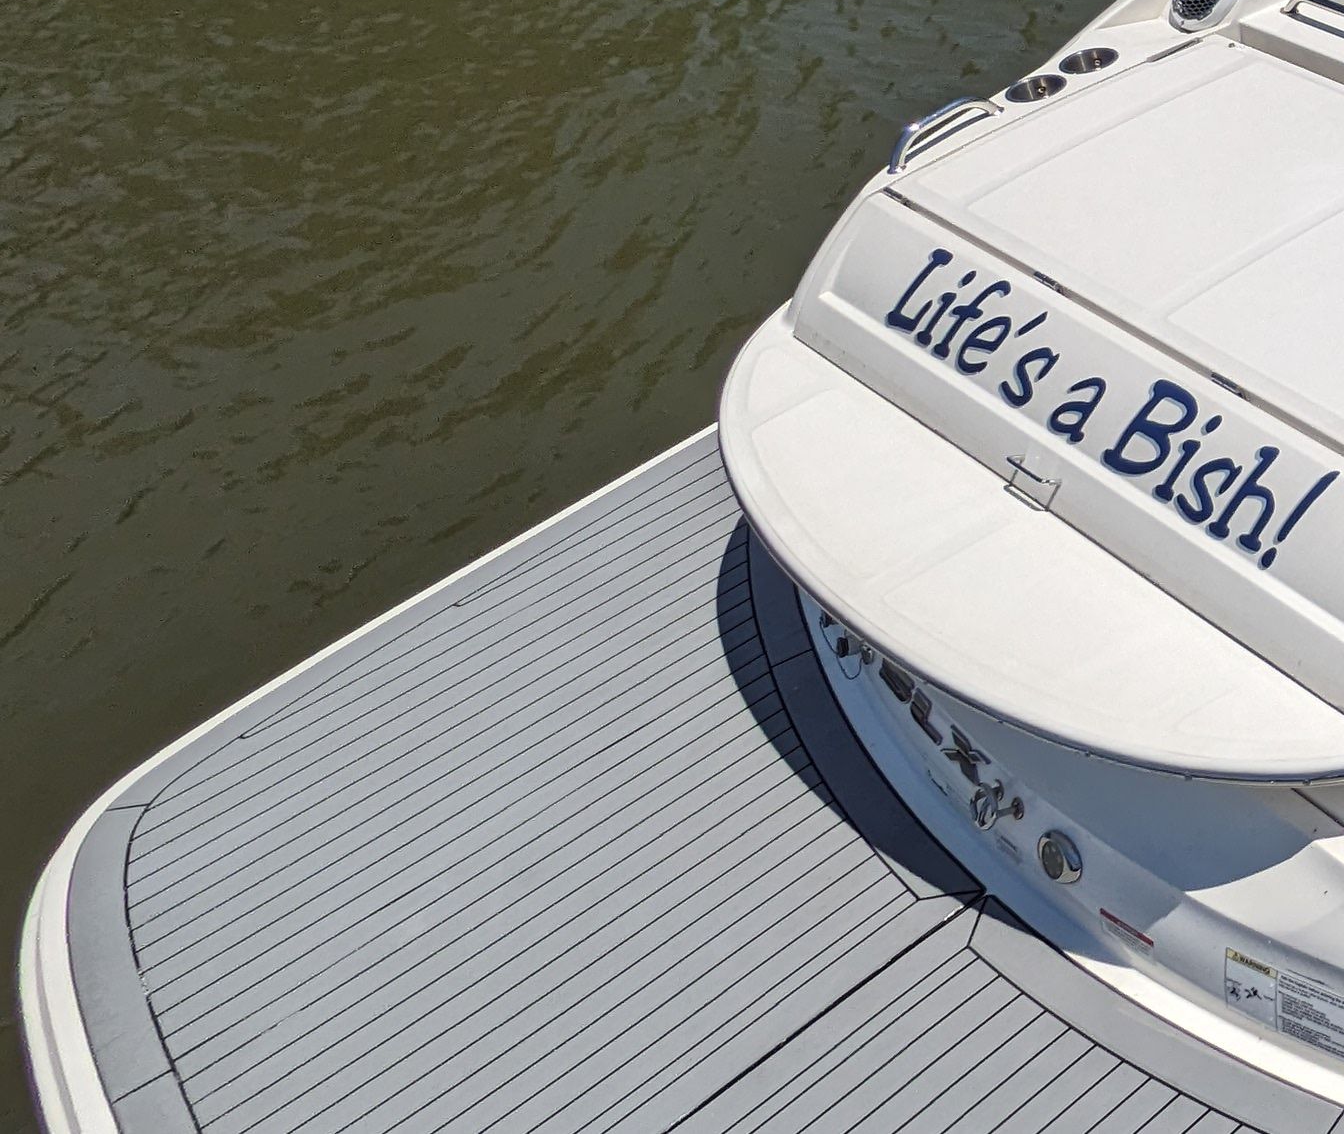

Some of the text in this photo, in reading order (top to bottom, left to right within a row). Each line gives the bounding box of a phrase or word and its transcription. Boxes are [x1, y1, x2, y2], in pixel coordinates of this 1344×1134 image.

[884, 247, 1343, 570] Life's a Bish!
